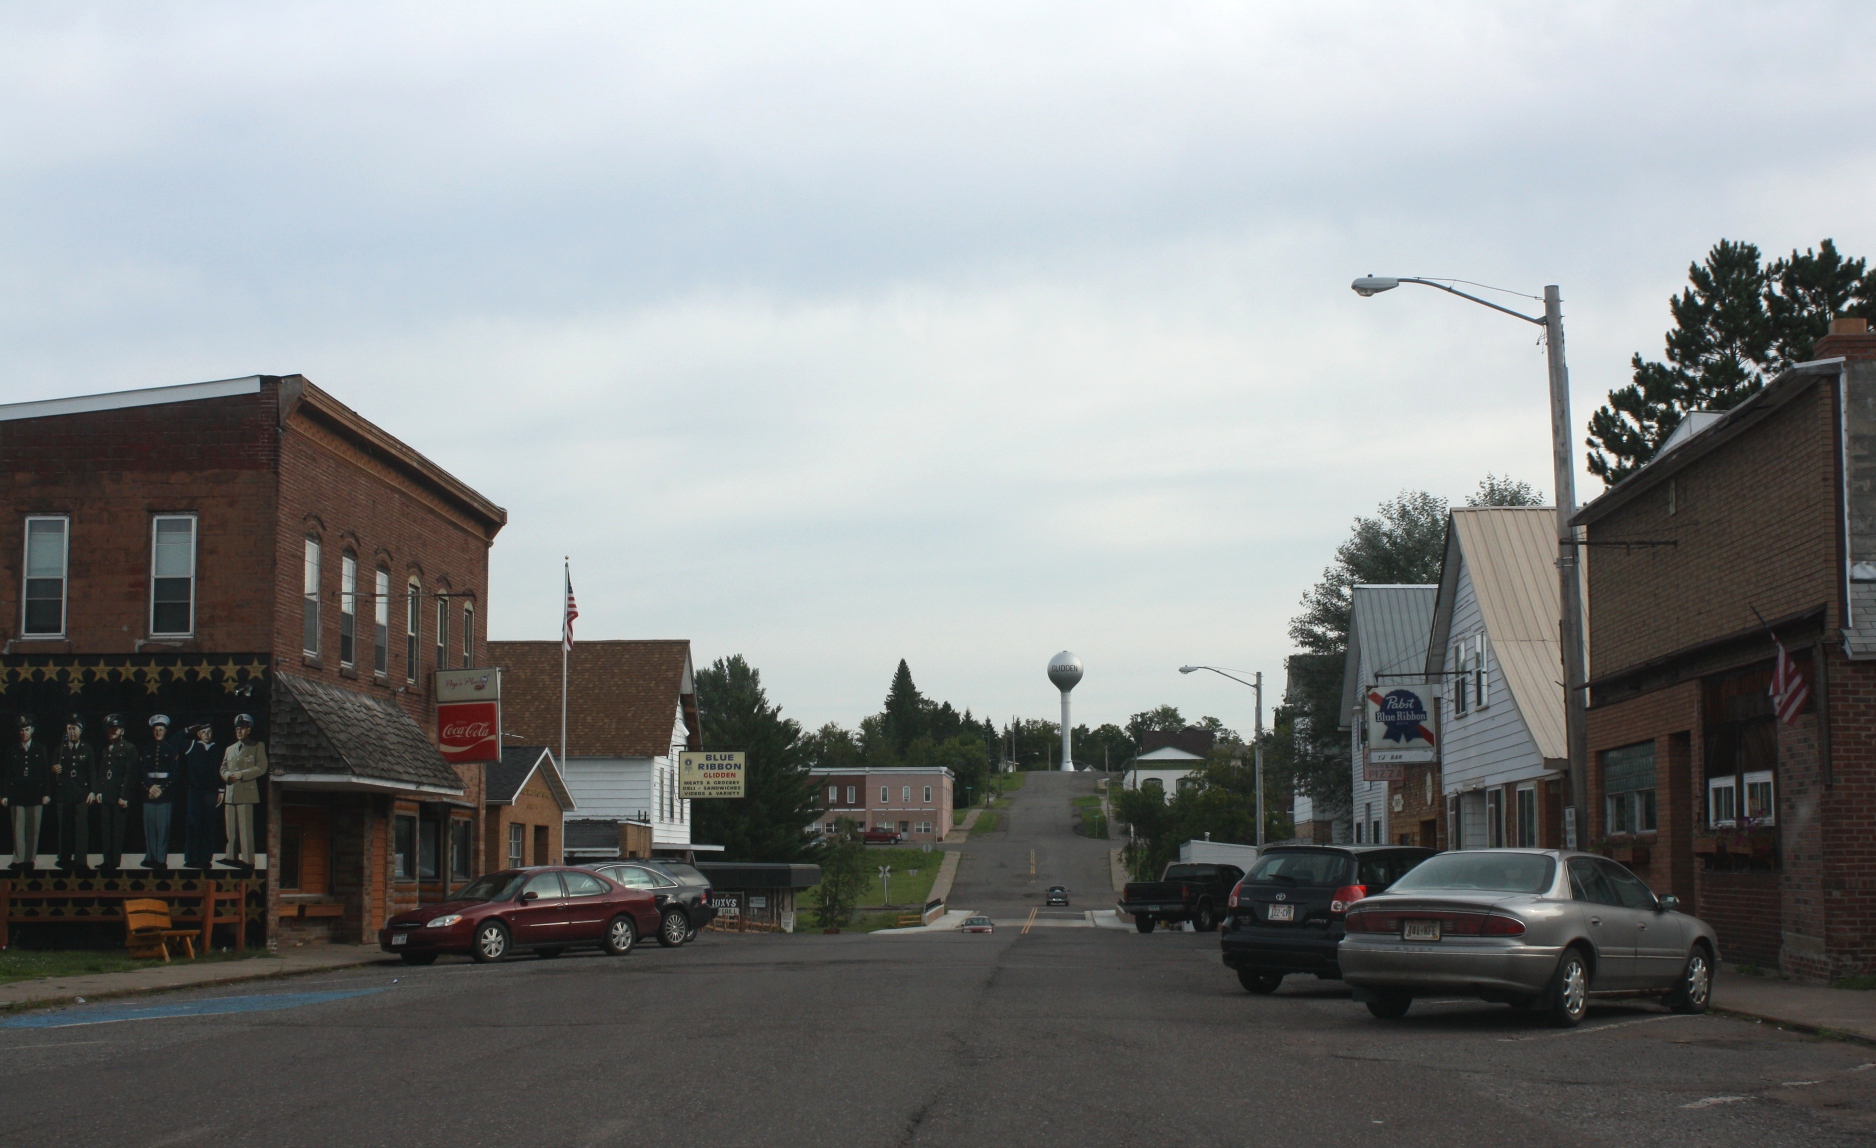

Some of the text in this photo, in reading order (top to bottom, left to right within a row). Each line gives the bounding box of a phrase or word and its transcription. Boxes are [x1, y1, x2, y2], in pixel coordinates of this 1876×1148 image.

[1051, 664, 1078, 672] GLIDDEN
[1386, 696, 1414, 709] Pabst
[1376, 710, 1426, 722] Blue Ribbon
[697, 763, 741, 771] RIBBON
[1368, 769, 1403, 779] PIZZA
